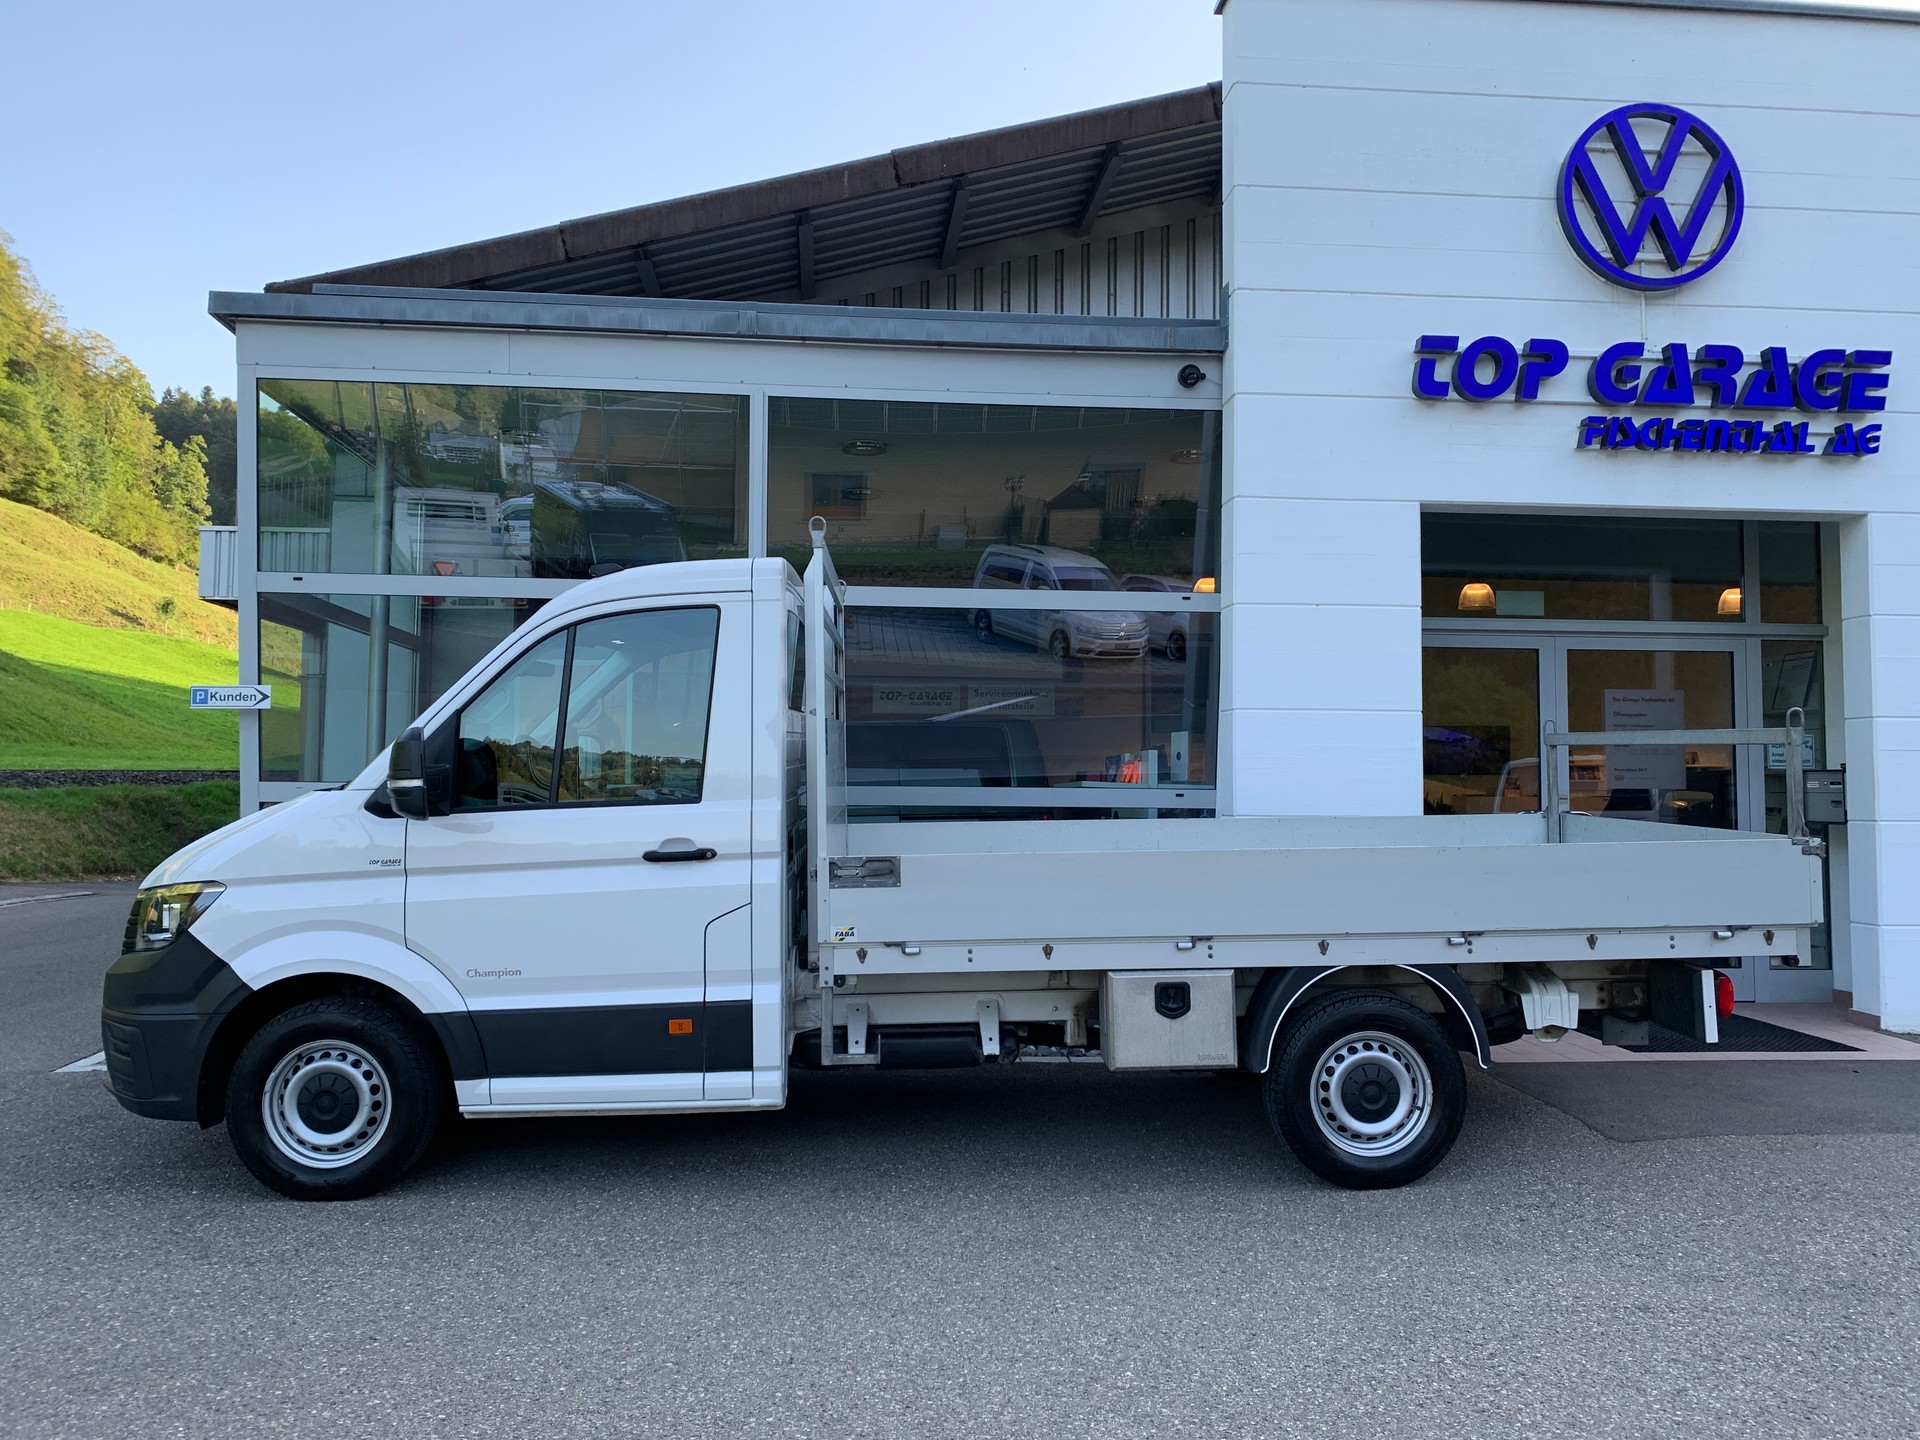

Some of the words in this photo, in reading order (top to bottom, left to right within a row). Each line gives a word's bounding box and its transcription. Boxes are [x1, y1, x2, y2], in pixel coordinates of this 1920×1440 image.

[1412, 335, 1569, 402] TOP
[1587, 342, 1893, 413] GARAGE
[1577, 416, 1815, 453] FISCHENTHAL
[1822, 423, 1882, 456] AG
[210, 692, 257, 702] Kunden
[880, 691, 953, 701] TOP-GARAGE
[466, 967, 522, 979] Champion
